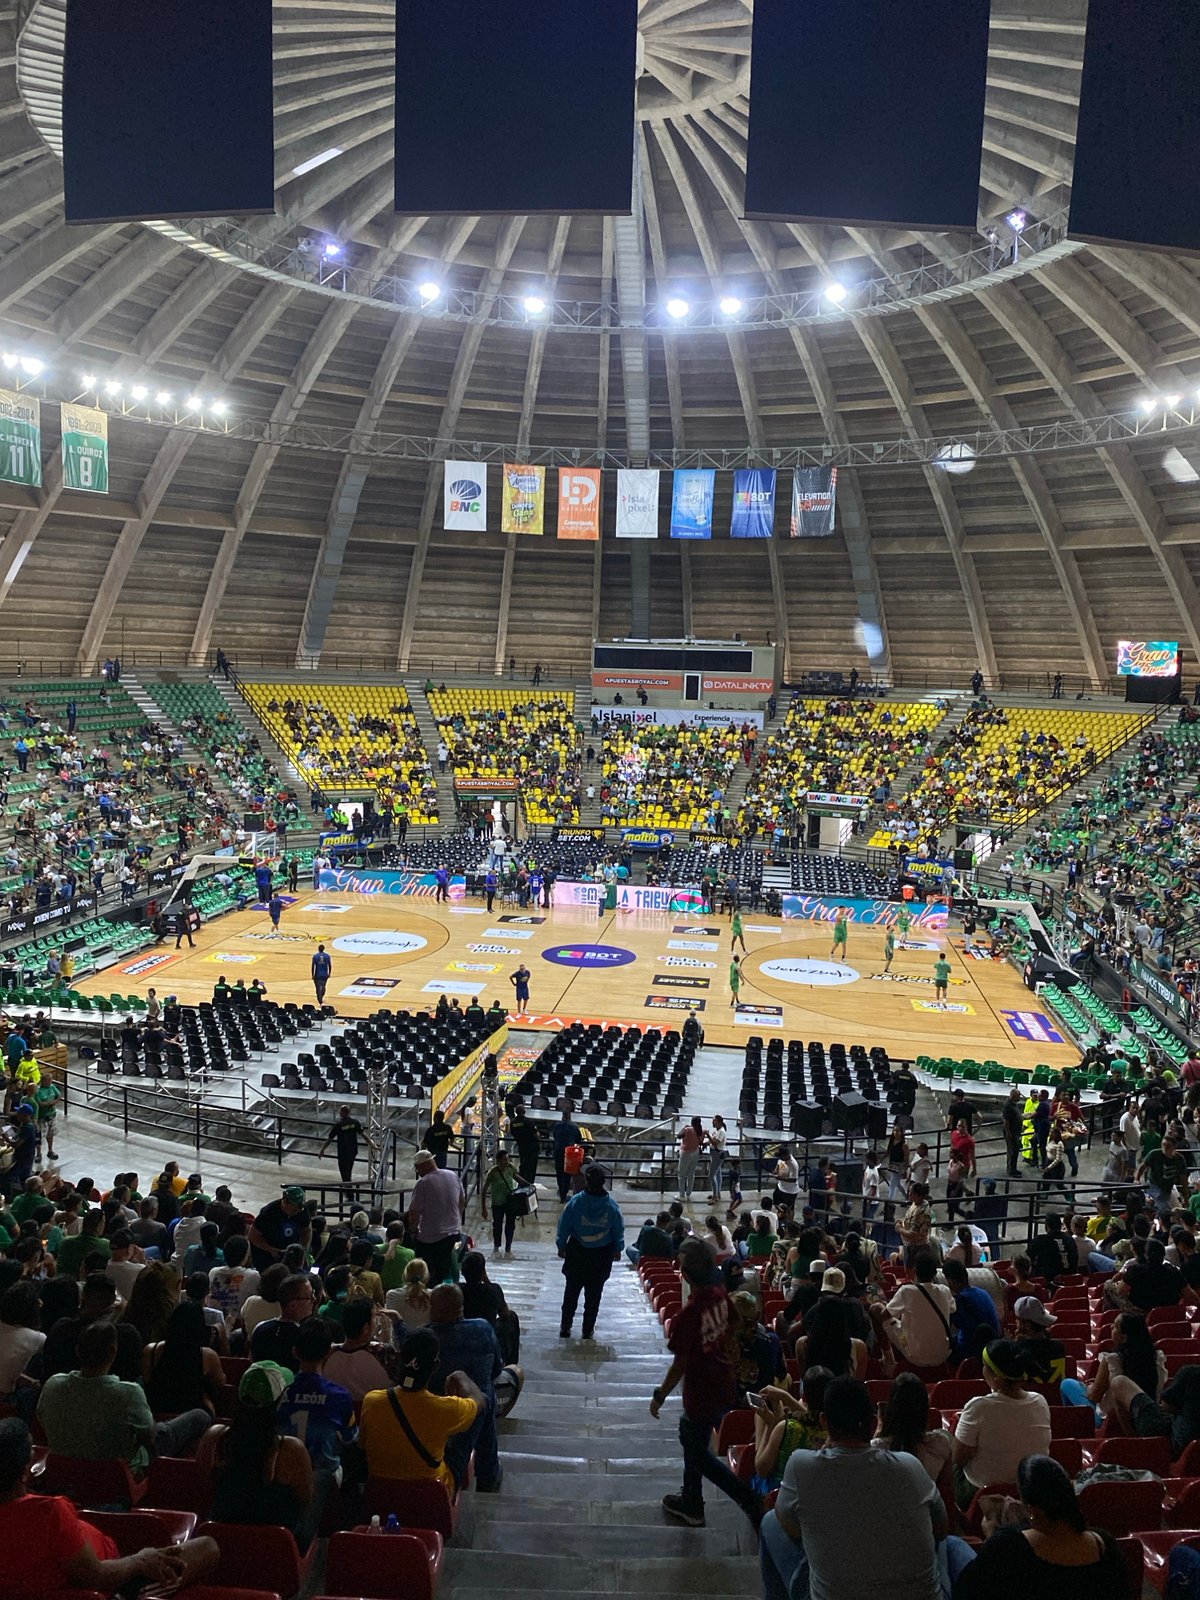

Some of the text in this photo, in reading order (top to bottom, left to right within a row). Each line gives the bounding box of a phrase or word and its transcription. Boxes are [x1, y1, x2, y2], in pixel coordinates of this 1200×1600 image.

[6, 433, 34, 447] HERRERA
[77, 445, 103, 459] QUIROZ
[9, 444, 24, 478] 11
[79, 456, 92, 487] 8
[797, 491, 832, 502] ELEVATION
[449, 500, 481, 513] BNC
[1124, 642, 1170, 666] Gran
[604, 677, 670, 687] APUESTASROYAL.COM
[714, 681, 772, 690] DATALINK TV
[694, 714, 730, 724] Experiencia
[829, 795, 848, 803] BNC
[850, 796, 868, 805] BN
[557, 834, 591, 842] BET.COM
[695, 835, 728, 843] TRIUNFO
[328, 870, 443, 898] Gran Fina
[792, 896, 857, 921] Gran
[33, 911, 50, 925] JOVEN
[584, 951, 622, 959] BDT
[294, 1391, 327, 1406] LEÓN
[289, 1410, 310, 1443] 1
